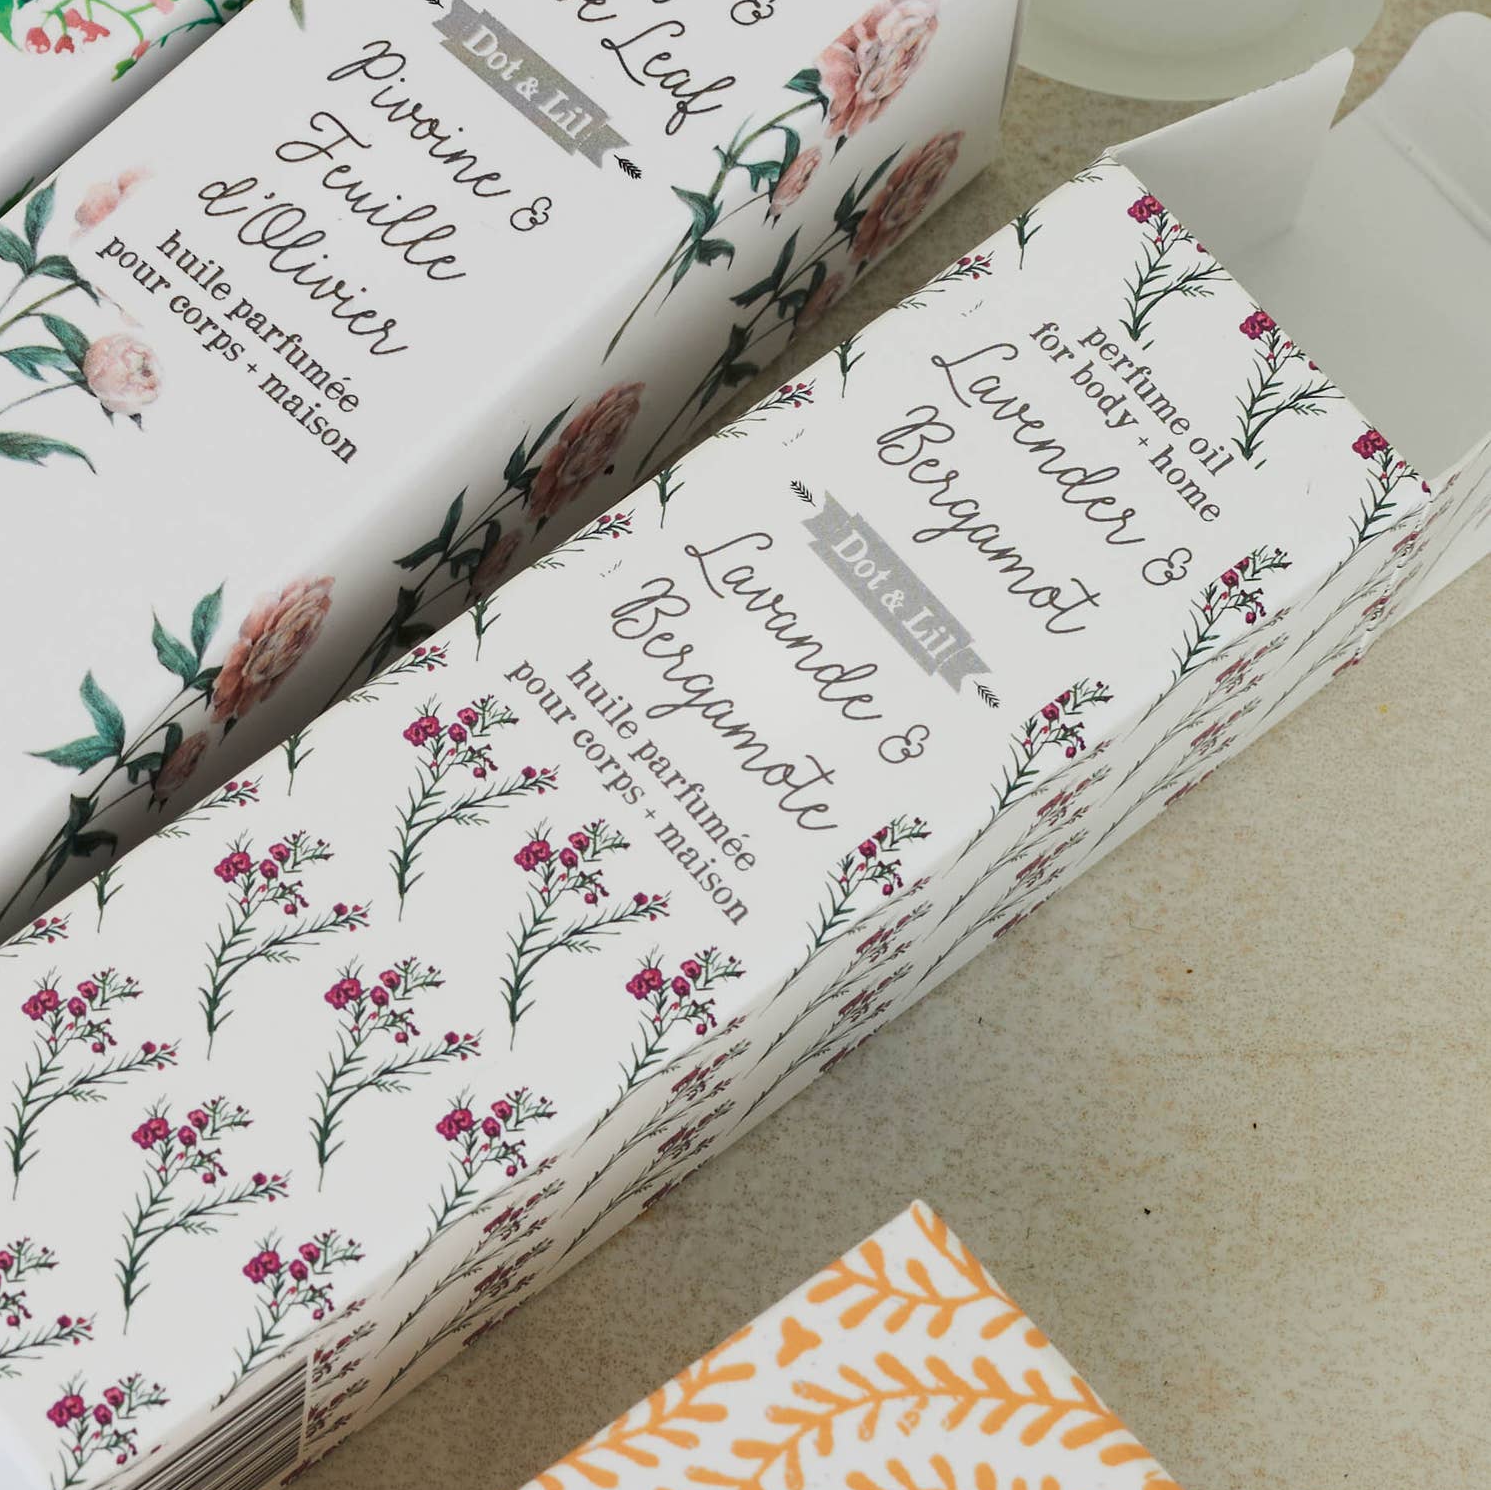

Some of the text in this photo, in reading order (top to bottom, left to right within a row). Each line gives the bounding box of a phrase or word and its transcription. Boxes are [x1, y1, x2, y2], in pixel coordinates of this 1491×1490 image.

[325, 39, 554, 233] Pivoine &
[462, 24, 593, 140] Dot Lil
[599, 19, 737, 137] Leaf
[197, 176, 410, 357] d'Olivier
[274, 110, 467, 282] Feuille
[94, 234, 358, 465] pour corps maison
[155, 228, 360, 413] huile parfumée
[1075, 325, 1235, 478] perfume oil
[875, 404, 1102, 635] Bergamot
[930, 342, 1194, 587] Lavender &
[1028, 321, 1221, 523] for body home
[683, 531, 931, 765] Lavande &
[830, 528, 957, 668] Dot Lil
[502, 658, 749, 927] pour corps maison
[565, 658, 757, 872] huile parfumée
[609, 576, 839, 832] Bergamote
